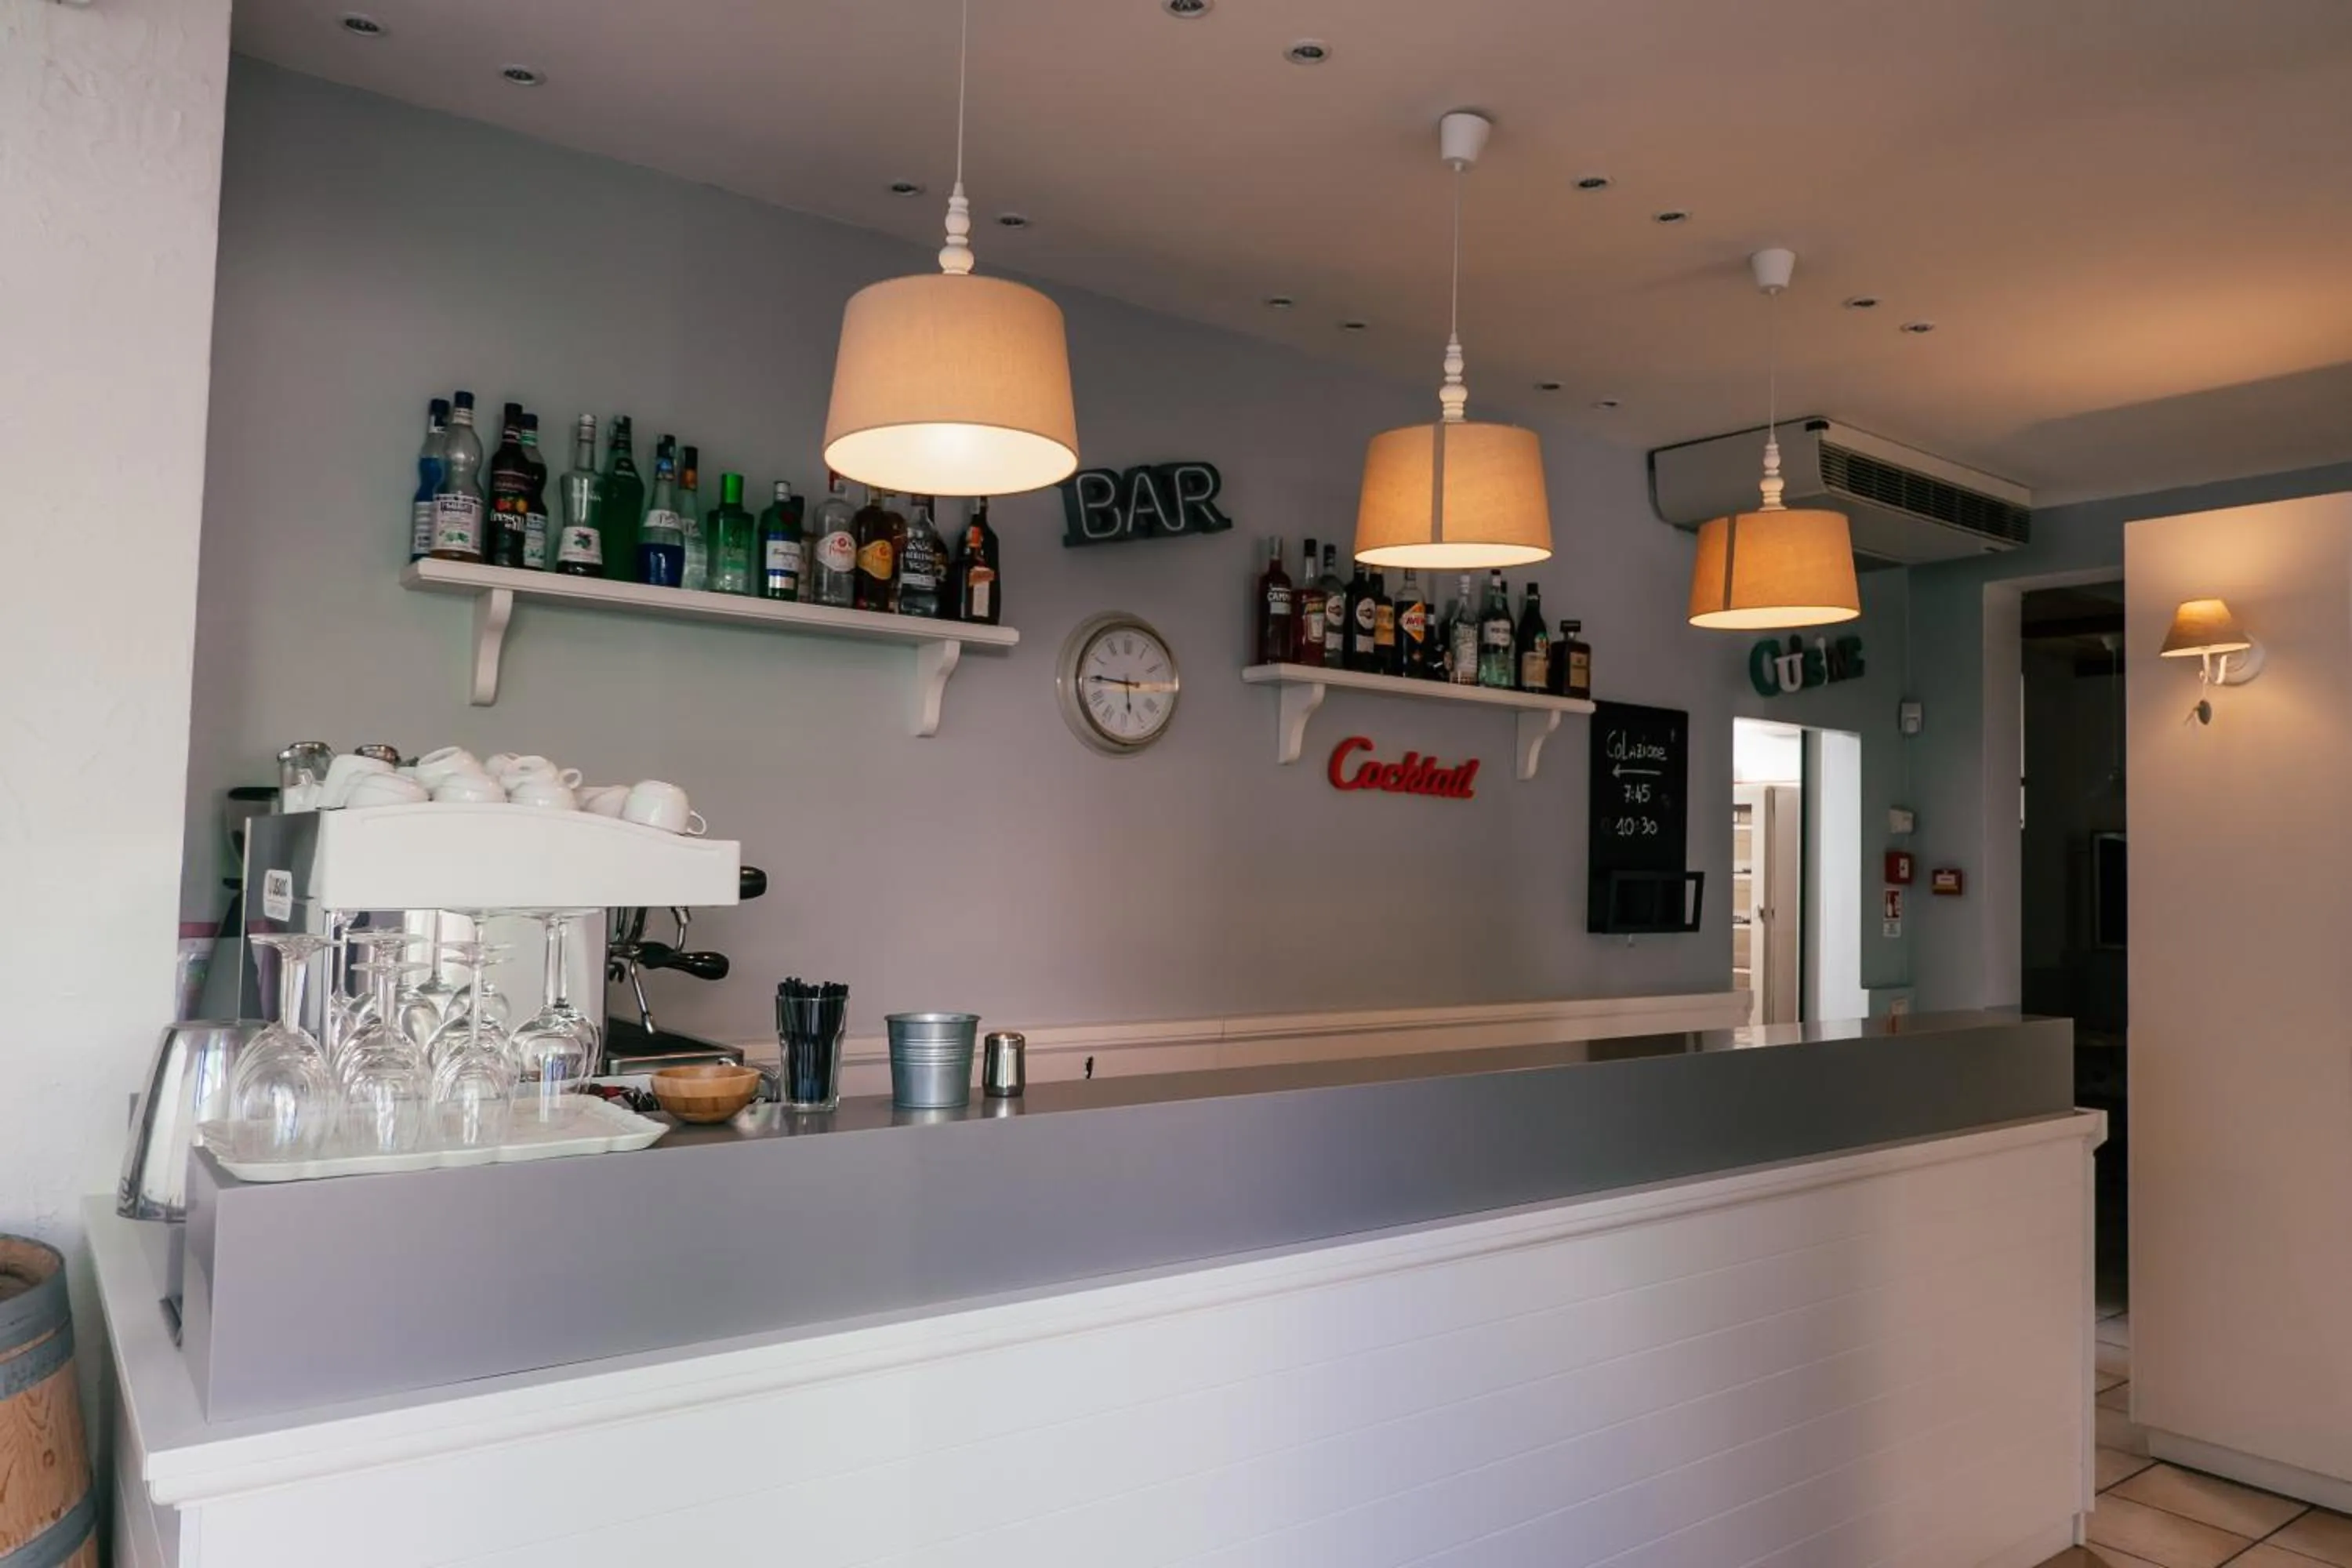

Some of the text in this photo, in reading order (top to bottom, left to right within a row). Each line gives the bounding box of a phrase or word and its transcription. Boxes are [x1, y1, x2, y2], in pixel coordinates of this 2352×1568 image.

[1058, 461, 1232, 547] BAR
[1327, 735, 1480, 799] Cocktail
[1623, 784, 1651, 804] 7:45
